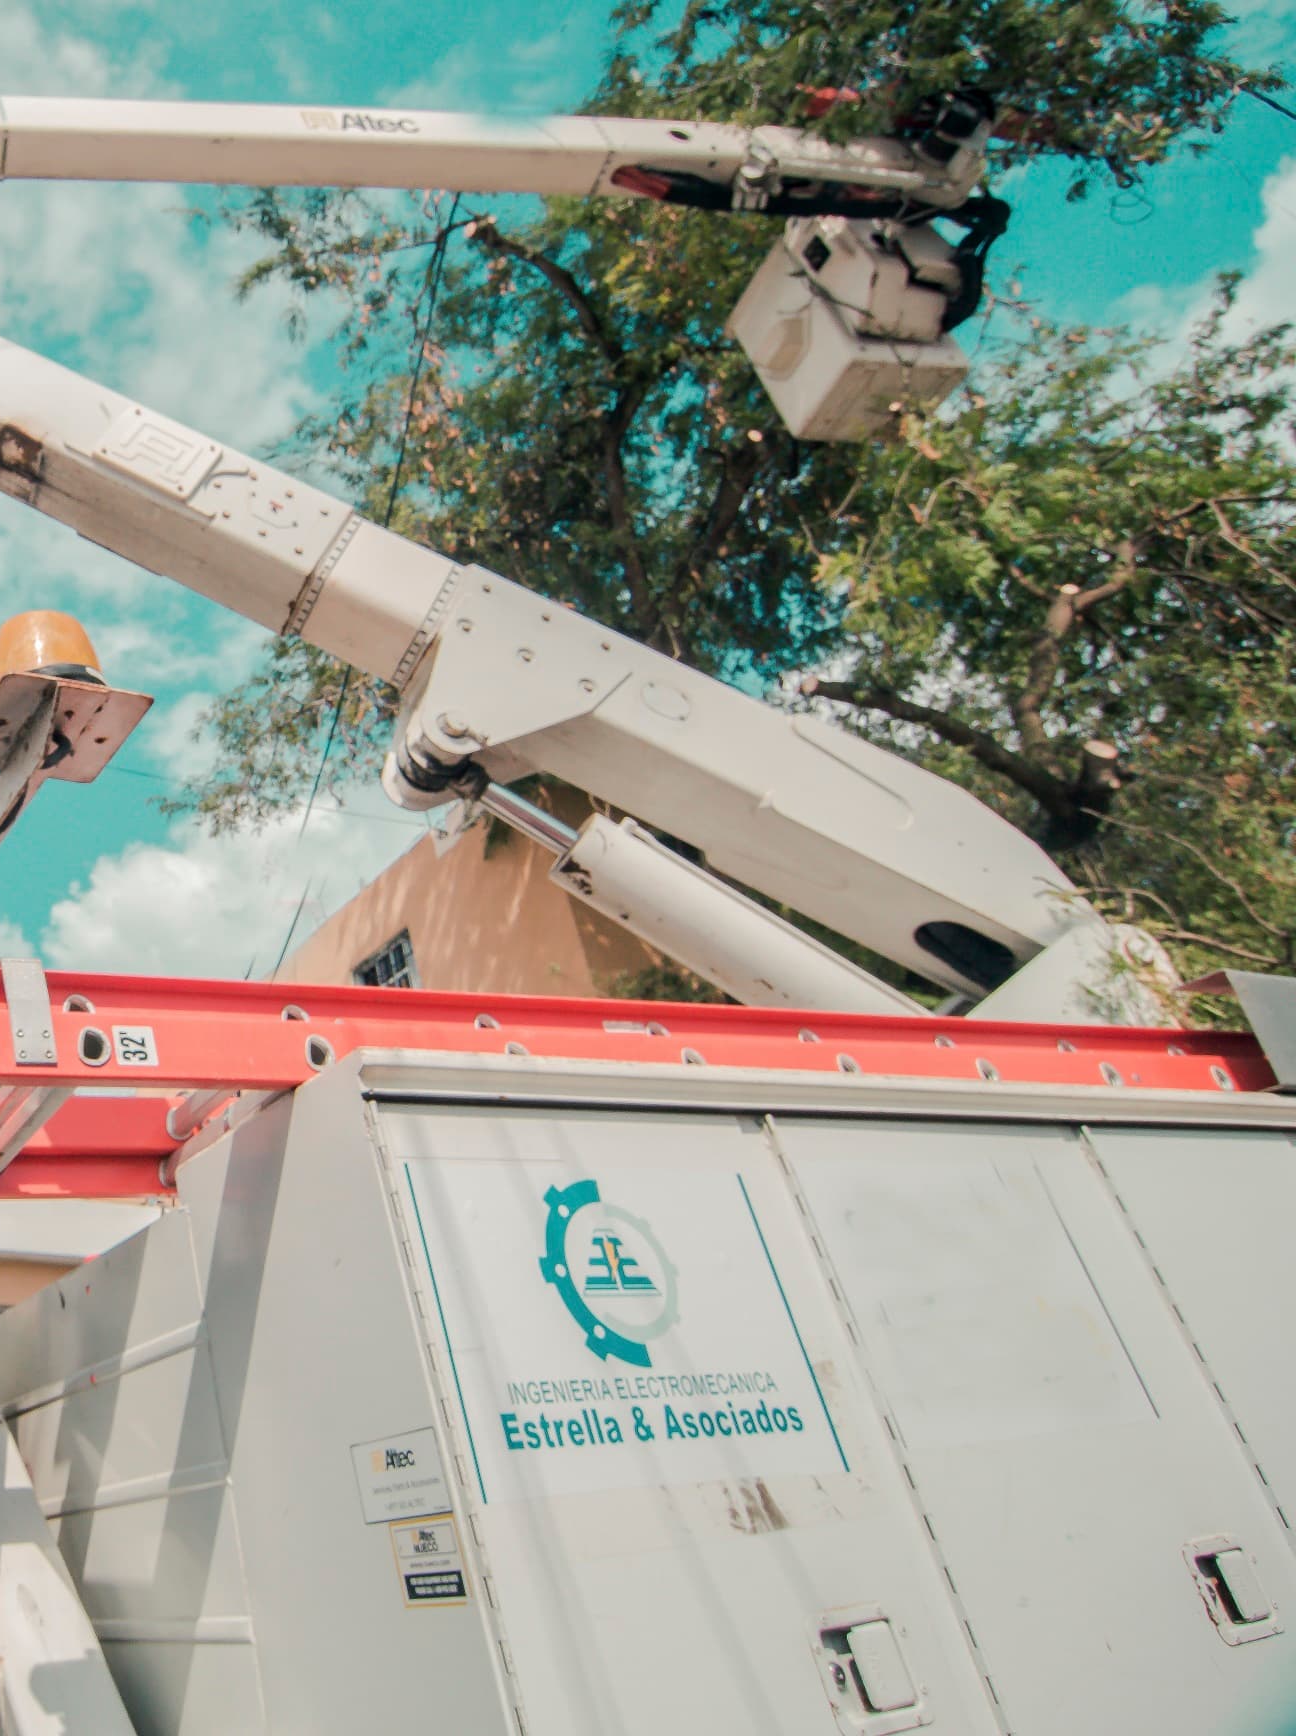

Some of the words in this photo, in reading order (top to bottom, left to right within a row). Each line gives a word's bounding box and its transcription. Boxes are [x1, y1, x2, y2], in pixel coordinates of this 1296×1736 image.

[341, 111, 421, 134] Altec
[507, 1377, 613, 1405] INGENIERIA
[615, 1371, 778, 1400] ELECTROMECANICA
[500, 1409, 623, 1450] Estrella
[632, 1406, 654, 1442] &
[664, 1399, 804, 1439] Asociados
[385, 1448, 415, 1470] Altec
